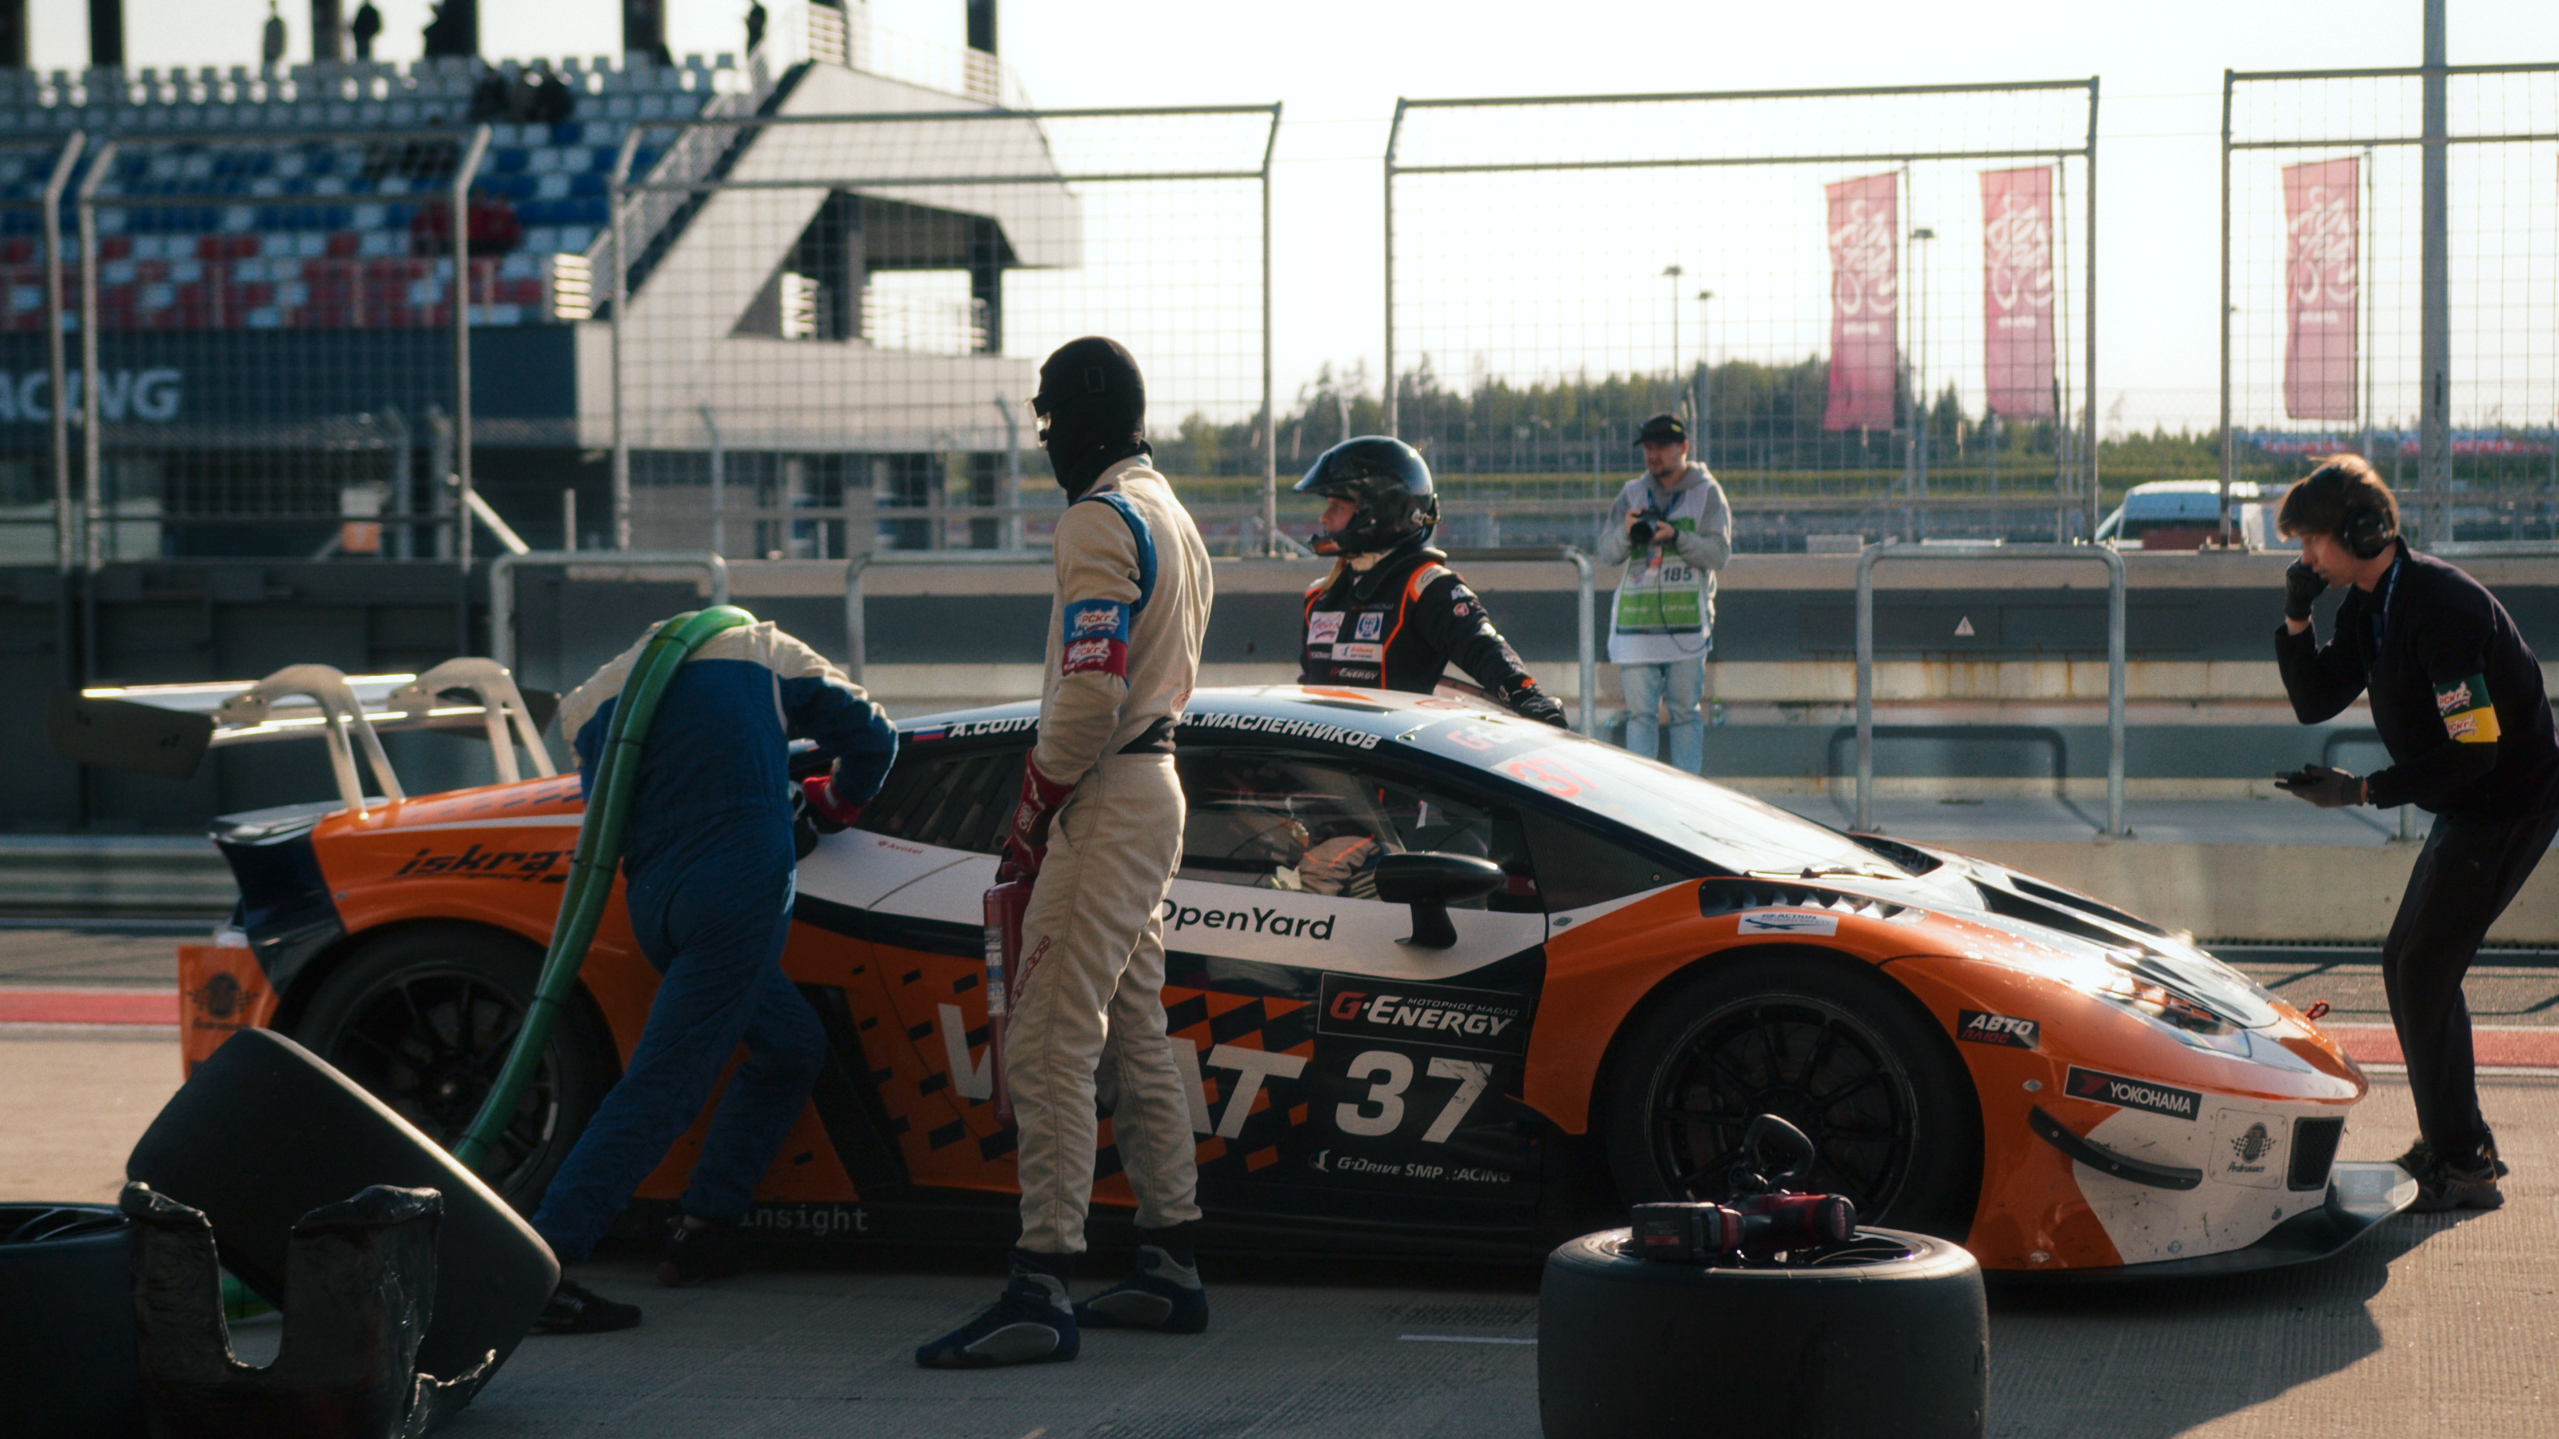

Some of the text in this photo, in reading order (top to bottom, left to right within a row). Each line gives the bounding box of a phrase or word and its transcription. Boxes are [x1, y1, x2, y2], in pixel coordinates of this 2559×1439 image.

[1662, 567, 1693, 581] 185
[948, 717, 1040, 738] А.СОЛУ
[1178, 711, 1382, 750] А.МАСЛЕННИКОВ
[394, 843, 577, 876] iskra
[1407, 997, 1474, 1011] МОТОРНОЕ
[1968, 1014, 2034, 1036] АВТО
[1962, 1029, 2010, 1044] ПЛЮС
[1336, 1050, 1493, 1143] 37
[2110, 1081, 2191, 1114] YOKOHAMA
[1404, 1163, 1444, 1179] SMP
[1446, 1168, 1511, 1182] ACING
